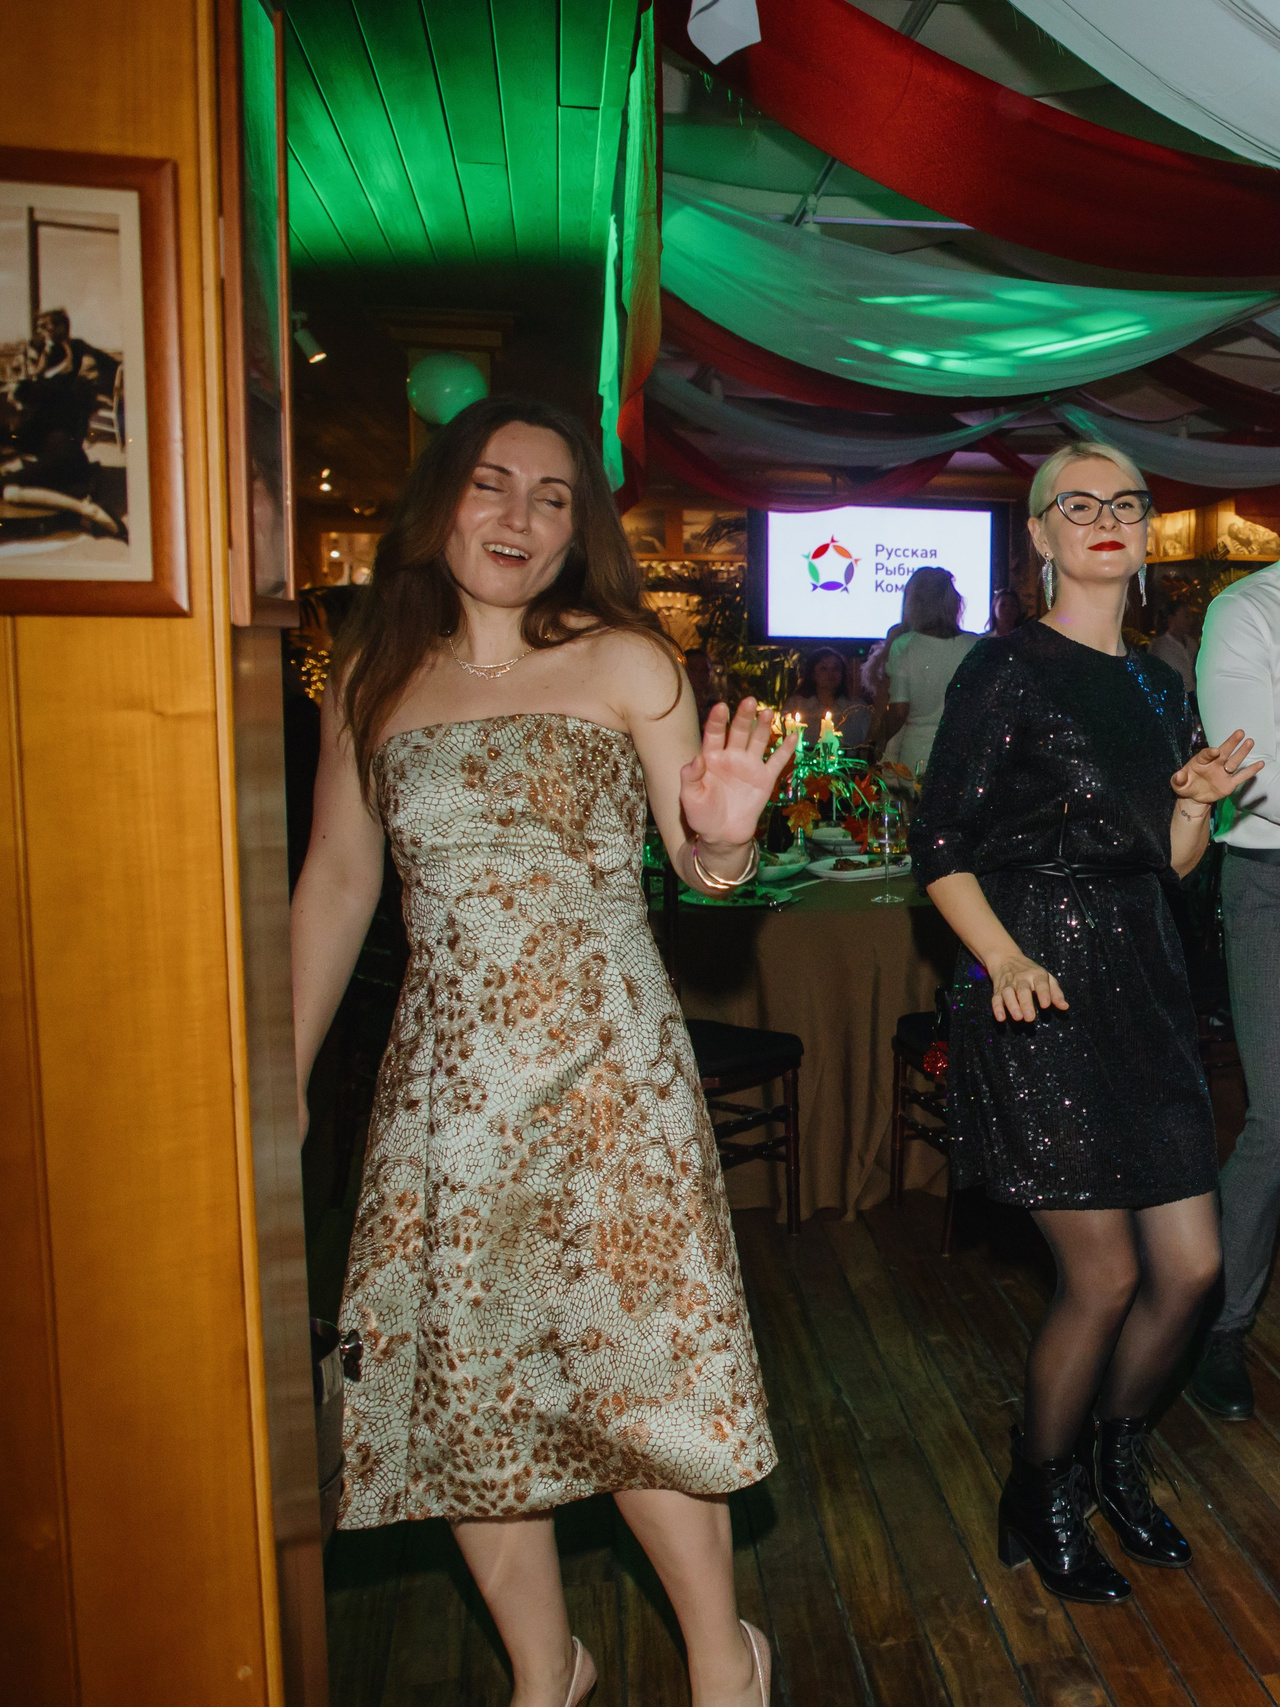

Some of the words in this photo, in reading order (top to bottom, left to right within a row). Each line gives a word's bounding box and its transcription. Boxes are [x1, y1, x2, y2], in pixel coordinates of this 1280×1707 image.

[875, 543, 937, 560] Русская
[875, 562, 915, 576] Рыбн
[875, 580, 905, 593] Ком
